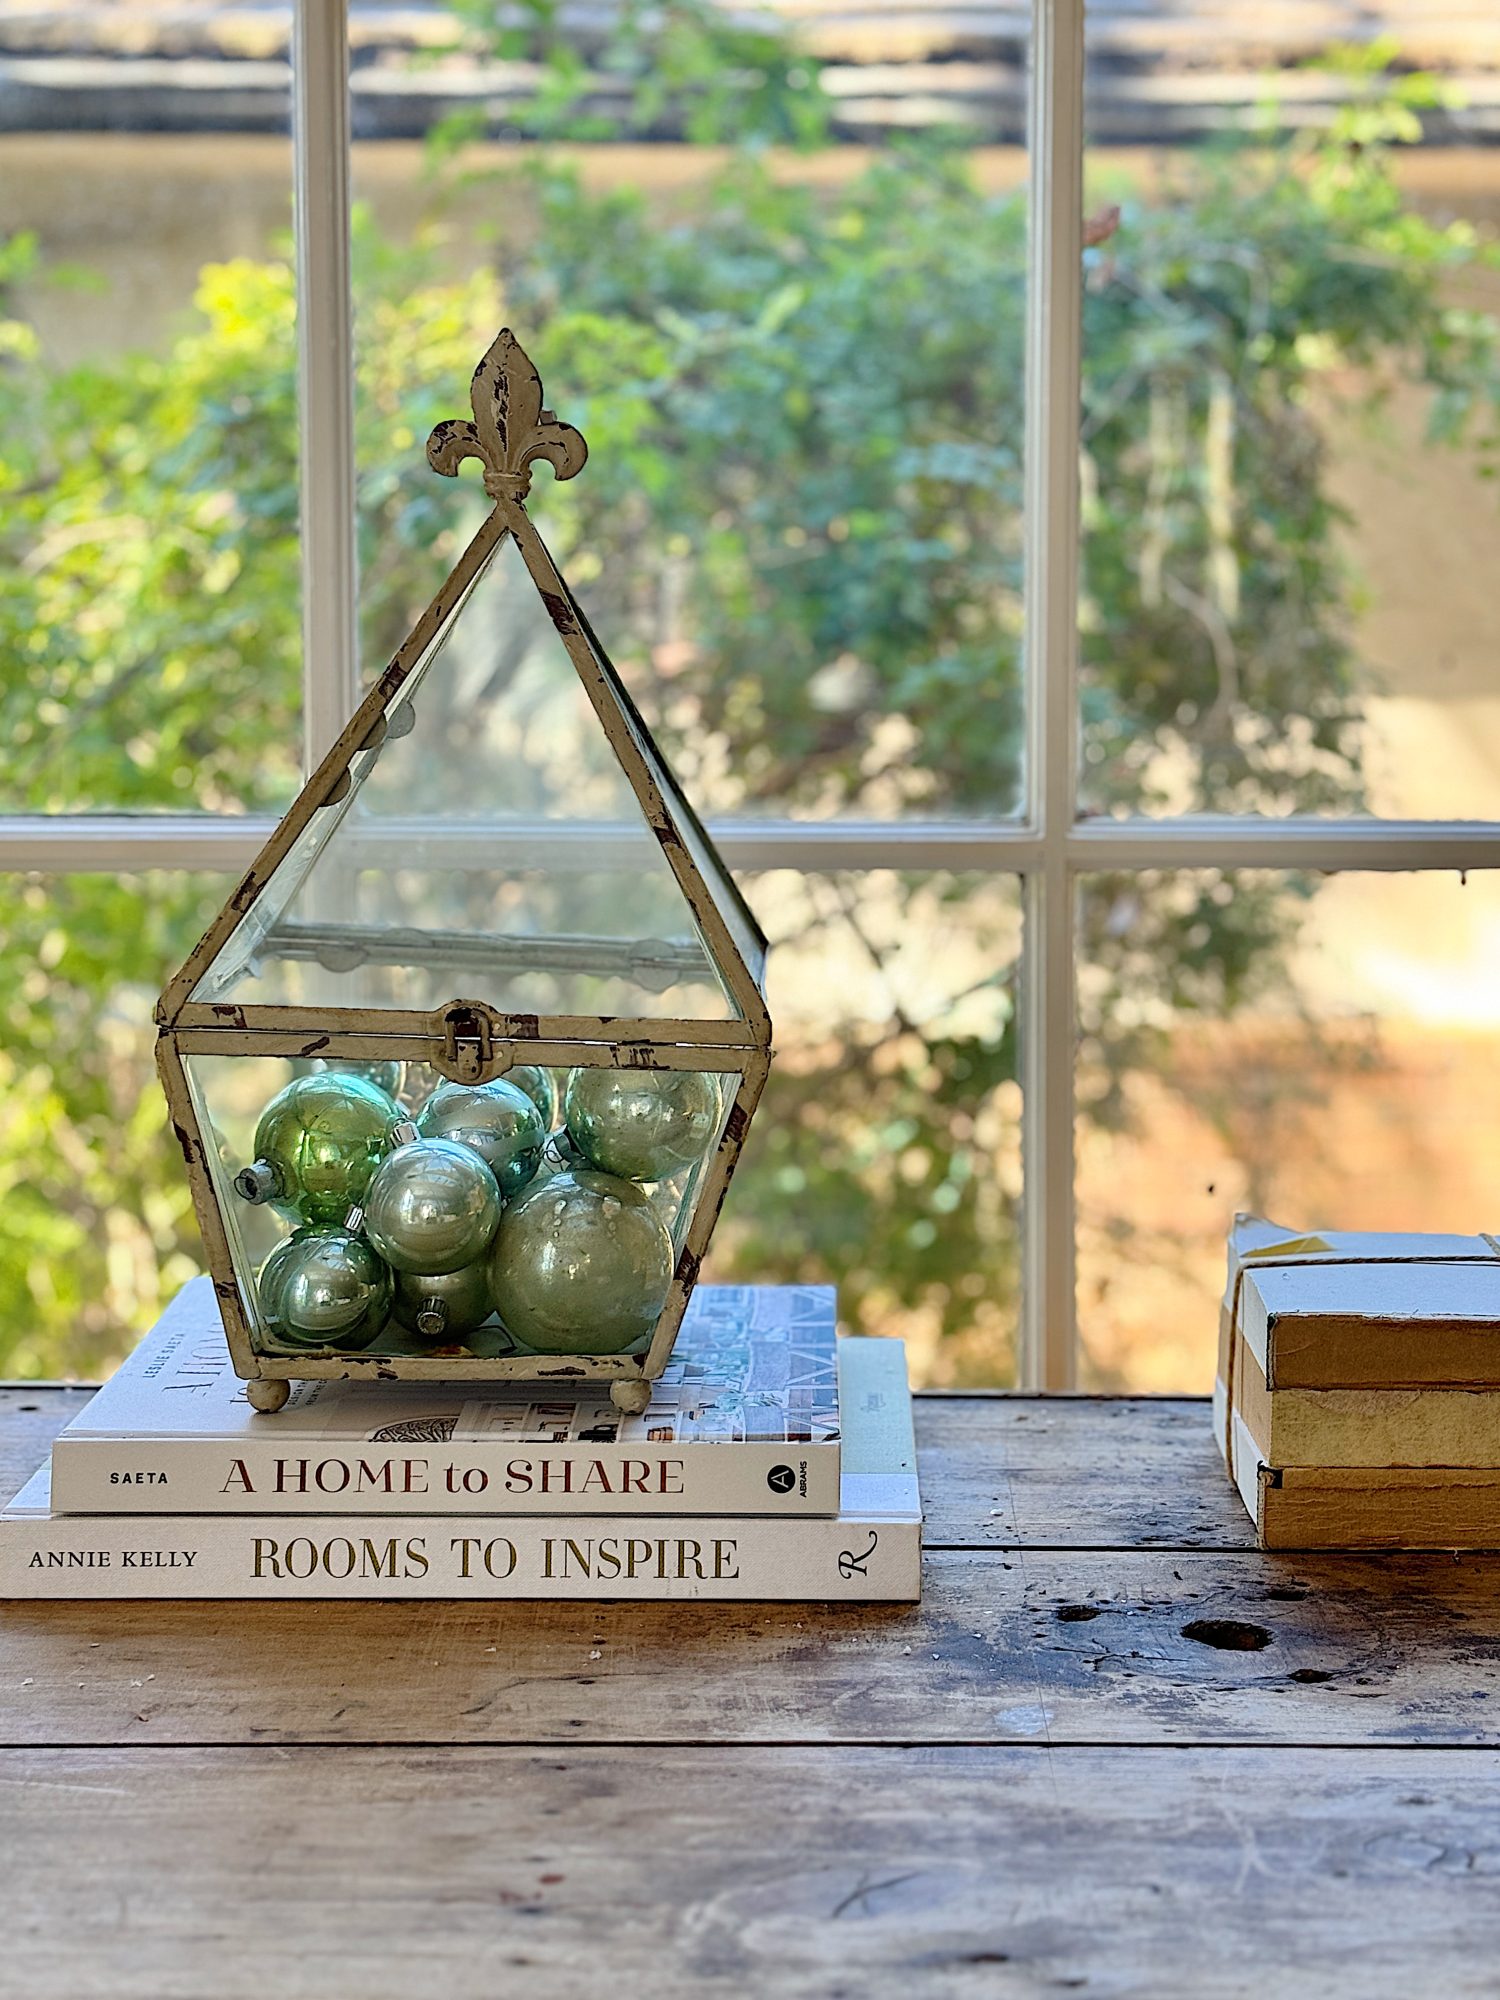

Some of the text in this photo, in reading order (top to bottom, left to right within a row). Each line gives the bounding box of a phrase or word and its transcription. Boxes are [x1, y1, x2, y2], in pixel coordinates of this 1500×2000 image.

[142, 1333, 185, 1378] LESLIE SAETA
[109, 1472, 168, 1485] SAETA
[218, 1459, 685, 1494] A HOME to SHARE
[799, 1460, 808, 1498] ABRAMS
[28, 1551, 199, 1568] ANNIE KELLY
[249, 1537, 740, 1580] ROOMS TO INSPIRE
